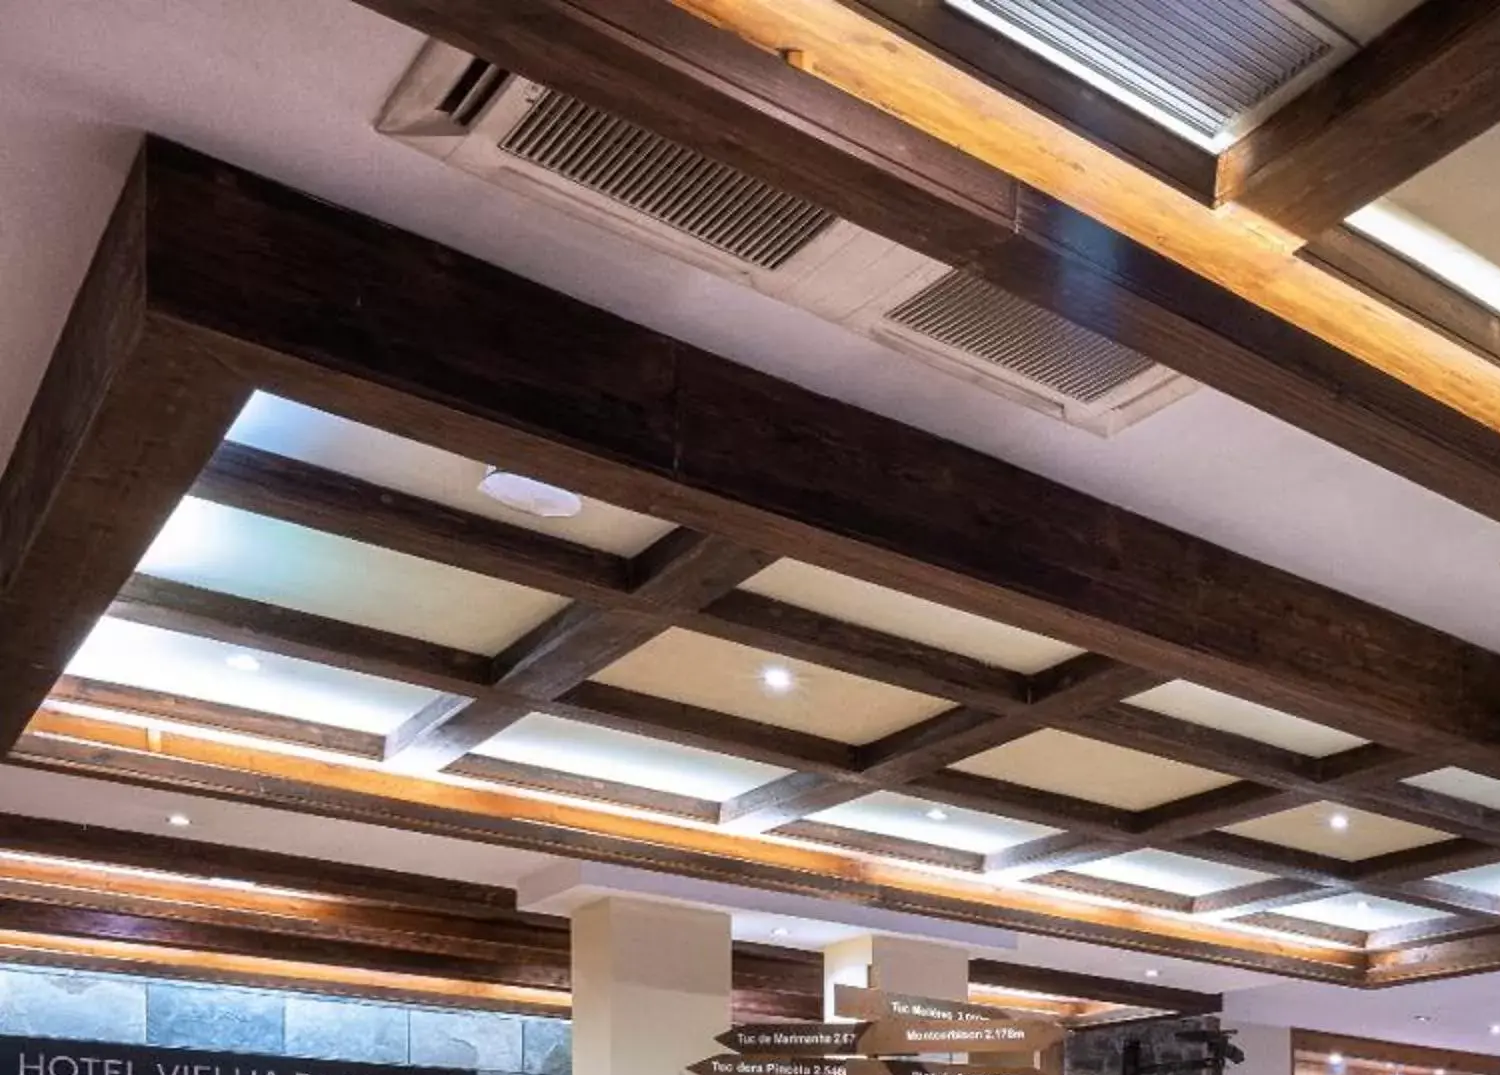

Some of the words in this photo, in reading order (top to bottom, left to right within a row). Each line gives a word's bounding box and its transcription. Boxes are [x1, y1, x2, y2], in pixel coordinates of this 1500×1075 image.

[737, 1033, 756, 1044] Tuc
[758, 1033, 773, 1044] de
[712, 1061, 733, 1073] Tuc
